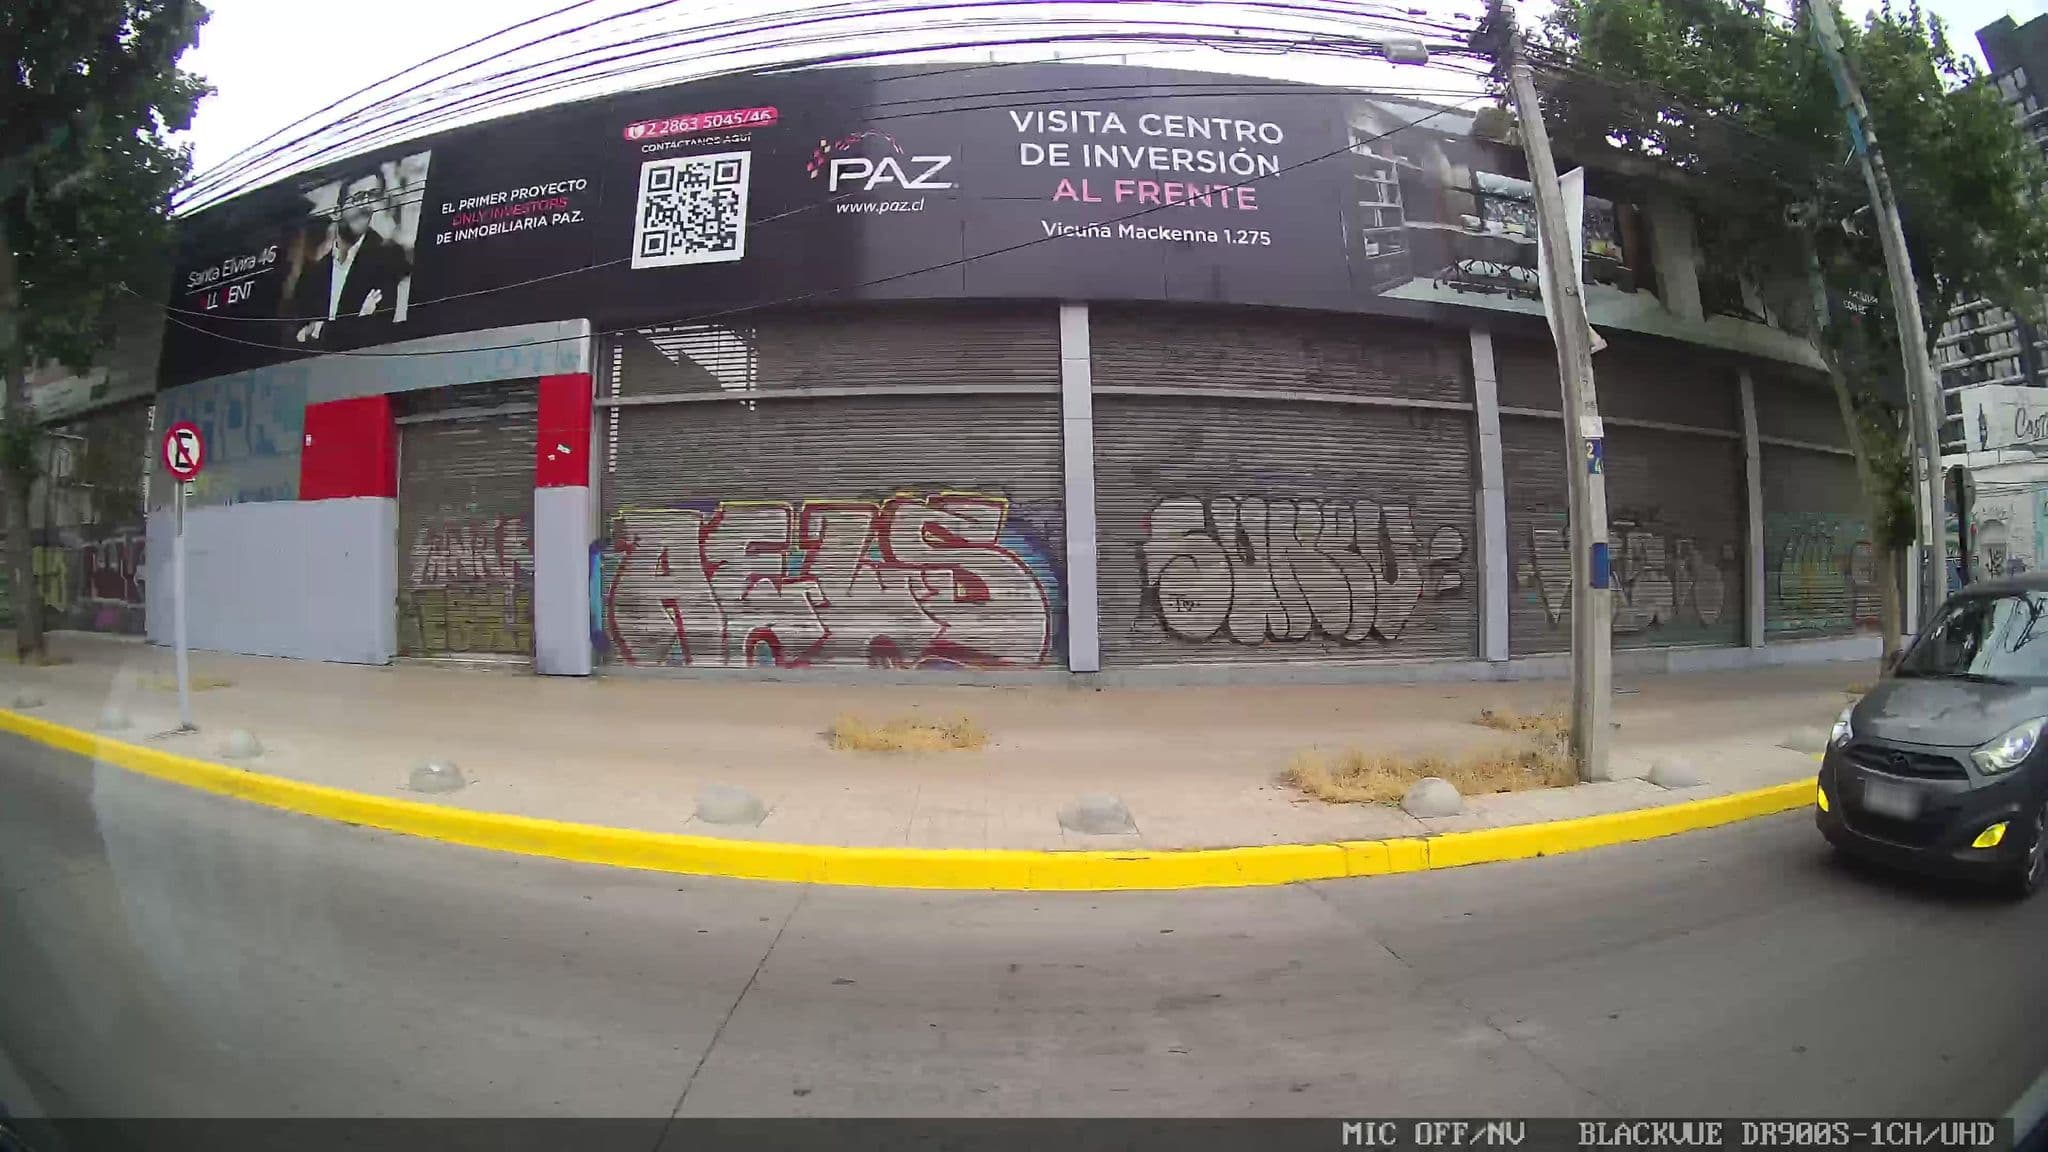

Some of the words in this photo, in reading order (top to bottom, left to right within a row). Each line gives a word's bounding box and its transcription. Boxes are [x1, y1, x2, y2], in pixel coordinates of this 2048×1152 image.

[660, 117, 699, 135] 2863
[703, 109, 772, 130] 5045/46
[1009, 110, 1127, 134] VISITA
[1138, 114, 1284, 145] CENTRO
[829, 155, 953, 192] PAZ
[1020, 143, 1070, 167] DE
[1083, 143, 1281, 177] INVERSIÓN
[441, 203, 456, 215] EL
[458, 191, 508, 211] PRIMER
[510, 179, 588, 201] PROYECTO
[836, 196, 925, 215] www.paz.cl
[1052, 178, 1102, 203] AL
[1114, 179, 1259, 211] FRENTE
[436, 232, 452, 245] DE
[454, 216, 548, 242] INMOBILIARIA
[551, 210, 585, 226] PAZ.
[1041, 220, 1112, 239] Vicuña
[1118, 223, 1219, 243] Mackenna
[1224, 229, 1272, 246] 1.275
